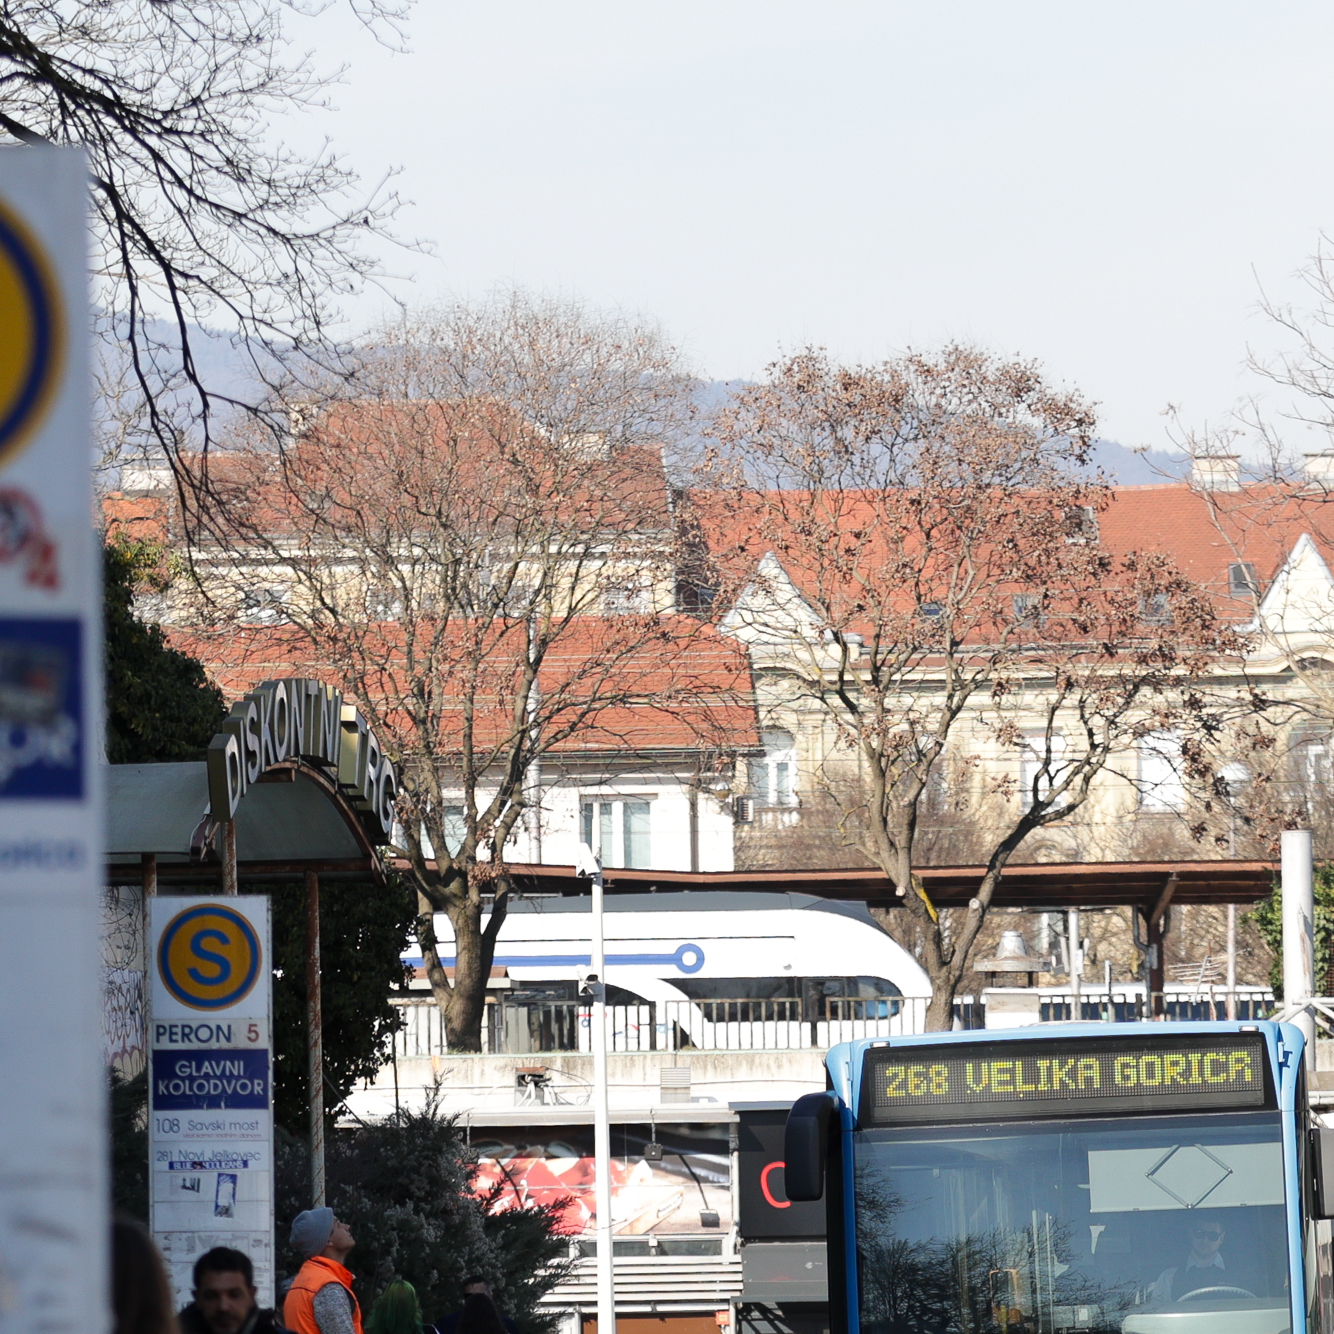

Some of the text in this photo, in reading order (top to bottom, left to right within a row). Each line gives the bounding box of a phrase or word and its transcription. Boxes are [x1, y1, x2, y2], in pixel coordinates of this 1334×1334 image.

[186, 928, 232, 987] S
[155, 1023, 260, 1043] PERON 5
[175, 1060, 244, 1077] GLAVNI
[885, 1050, 1252, 1097] 268 VELIKA GORICA
[158, 1079, 264, 1096] KOLODVOR
[156, 1118, 260, 1134] 108 Savski most
[157, 1149, 262, 1162] 281 Novi Jelkovec
